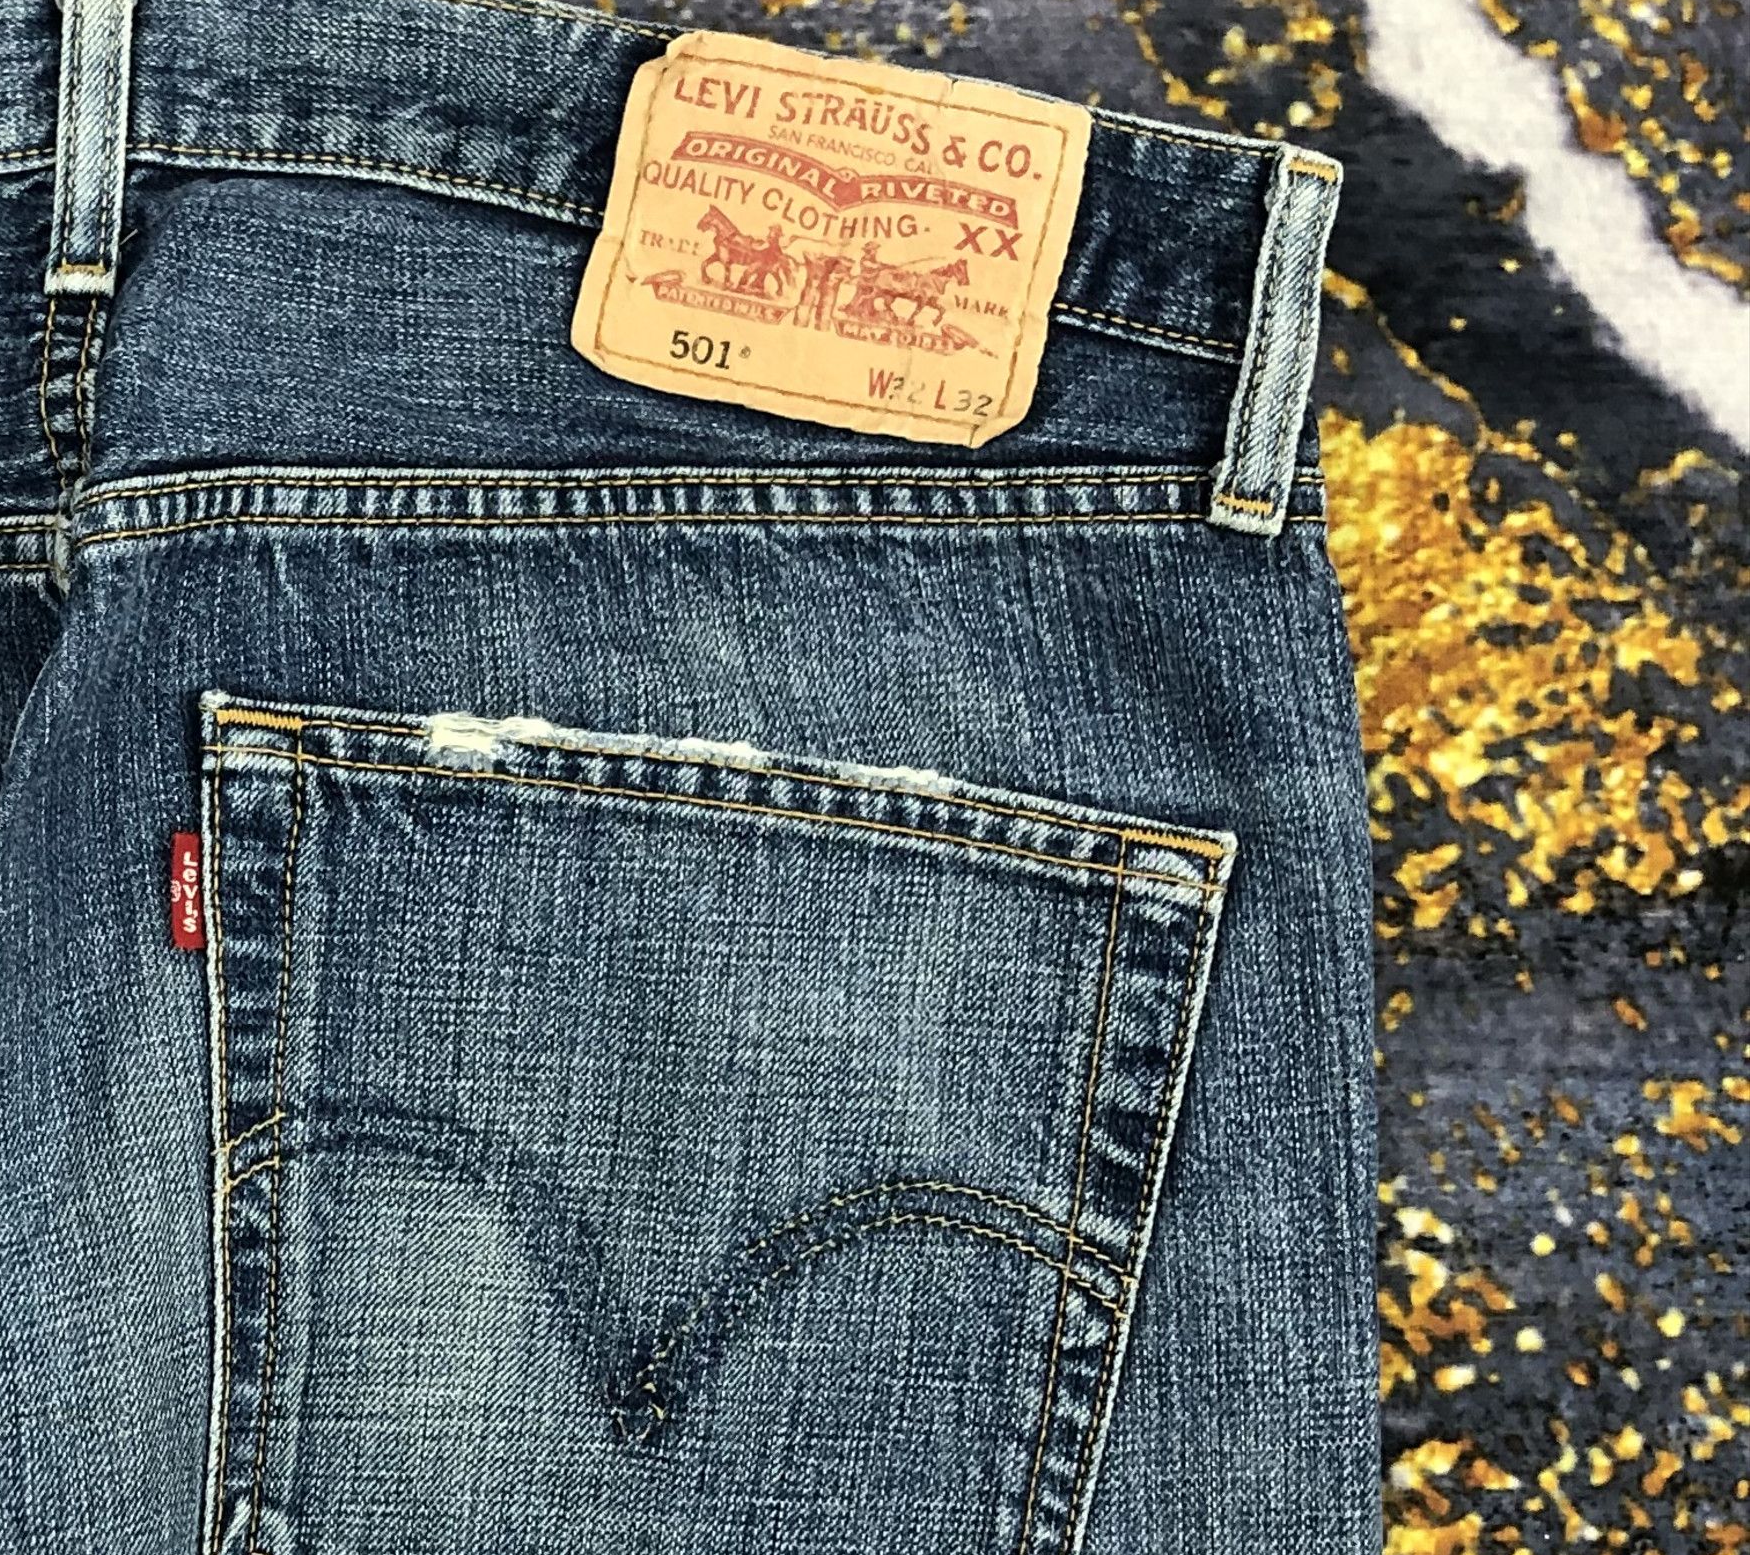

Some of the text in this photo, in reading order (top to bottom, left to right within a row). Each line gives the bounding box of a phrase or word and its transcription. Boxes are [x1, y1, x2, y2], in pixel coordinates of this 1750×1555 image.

[674, 77, 762, 119] LEVI
[942, 134, 968, 169] &
[978, 140, 1042, 180] CO.
[768, 125, 803, 145] SAN
[806, 134, 896, 166] FRANCISCO
[642, 160, 755, 205] QUALITY
[686, 139, 1010, 217] ORIGINAL RIVETED
[954, 222, 1023, 262] XX
